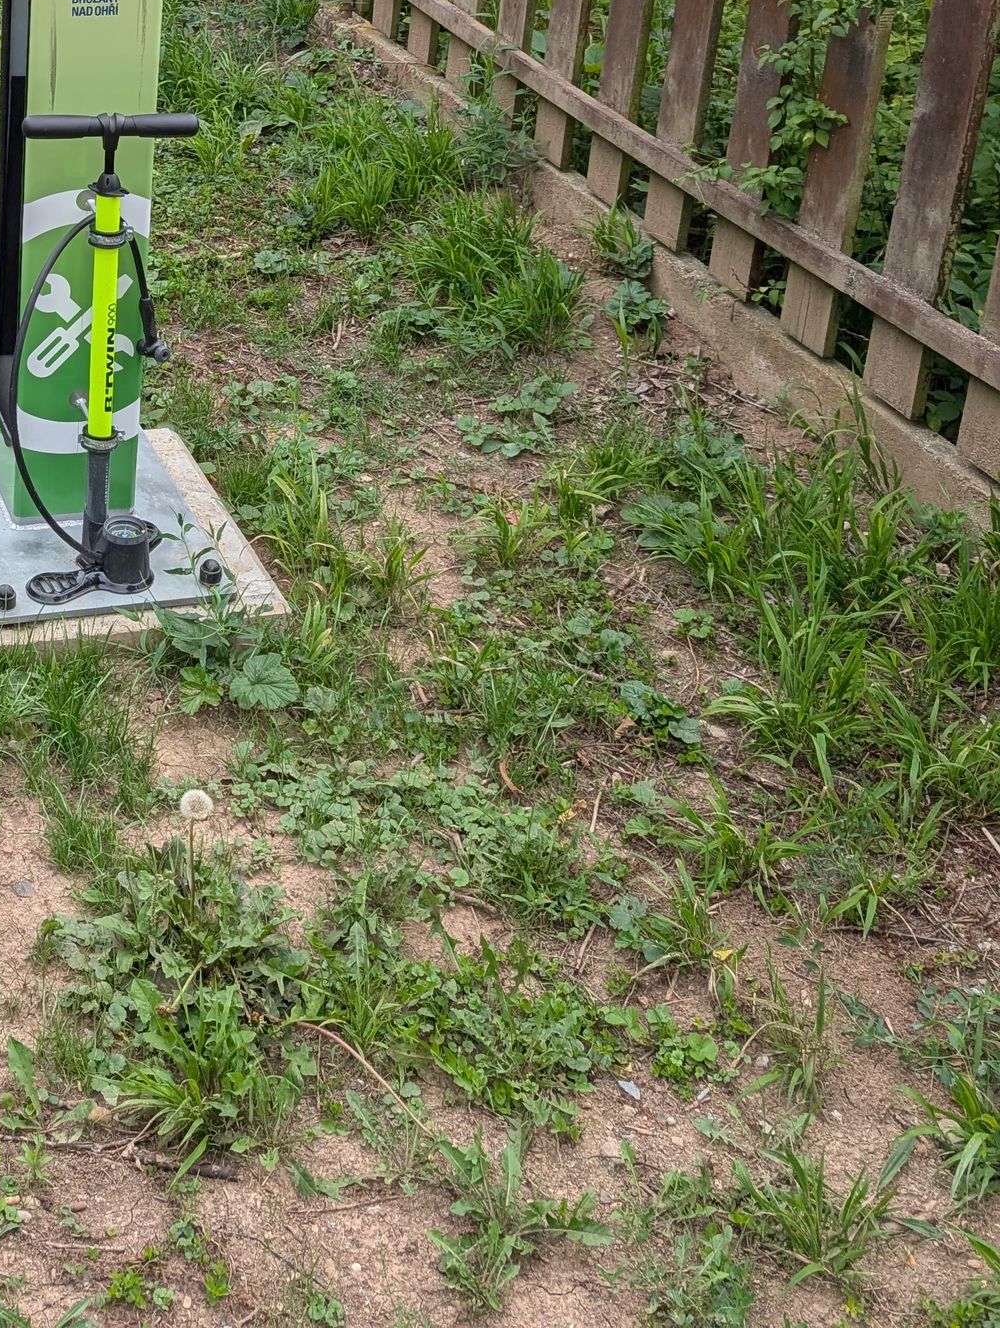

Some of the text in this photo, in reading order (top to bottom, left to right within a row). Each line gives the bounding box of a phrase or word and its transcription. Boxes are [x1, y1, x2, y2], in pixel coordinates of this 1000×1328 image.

[71, 3, 120, 17] NAD OHŘÍ
[107, 303, 116, 326] 900
